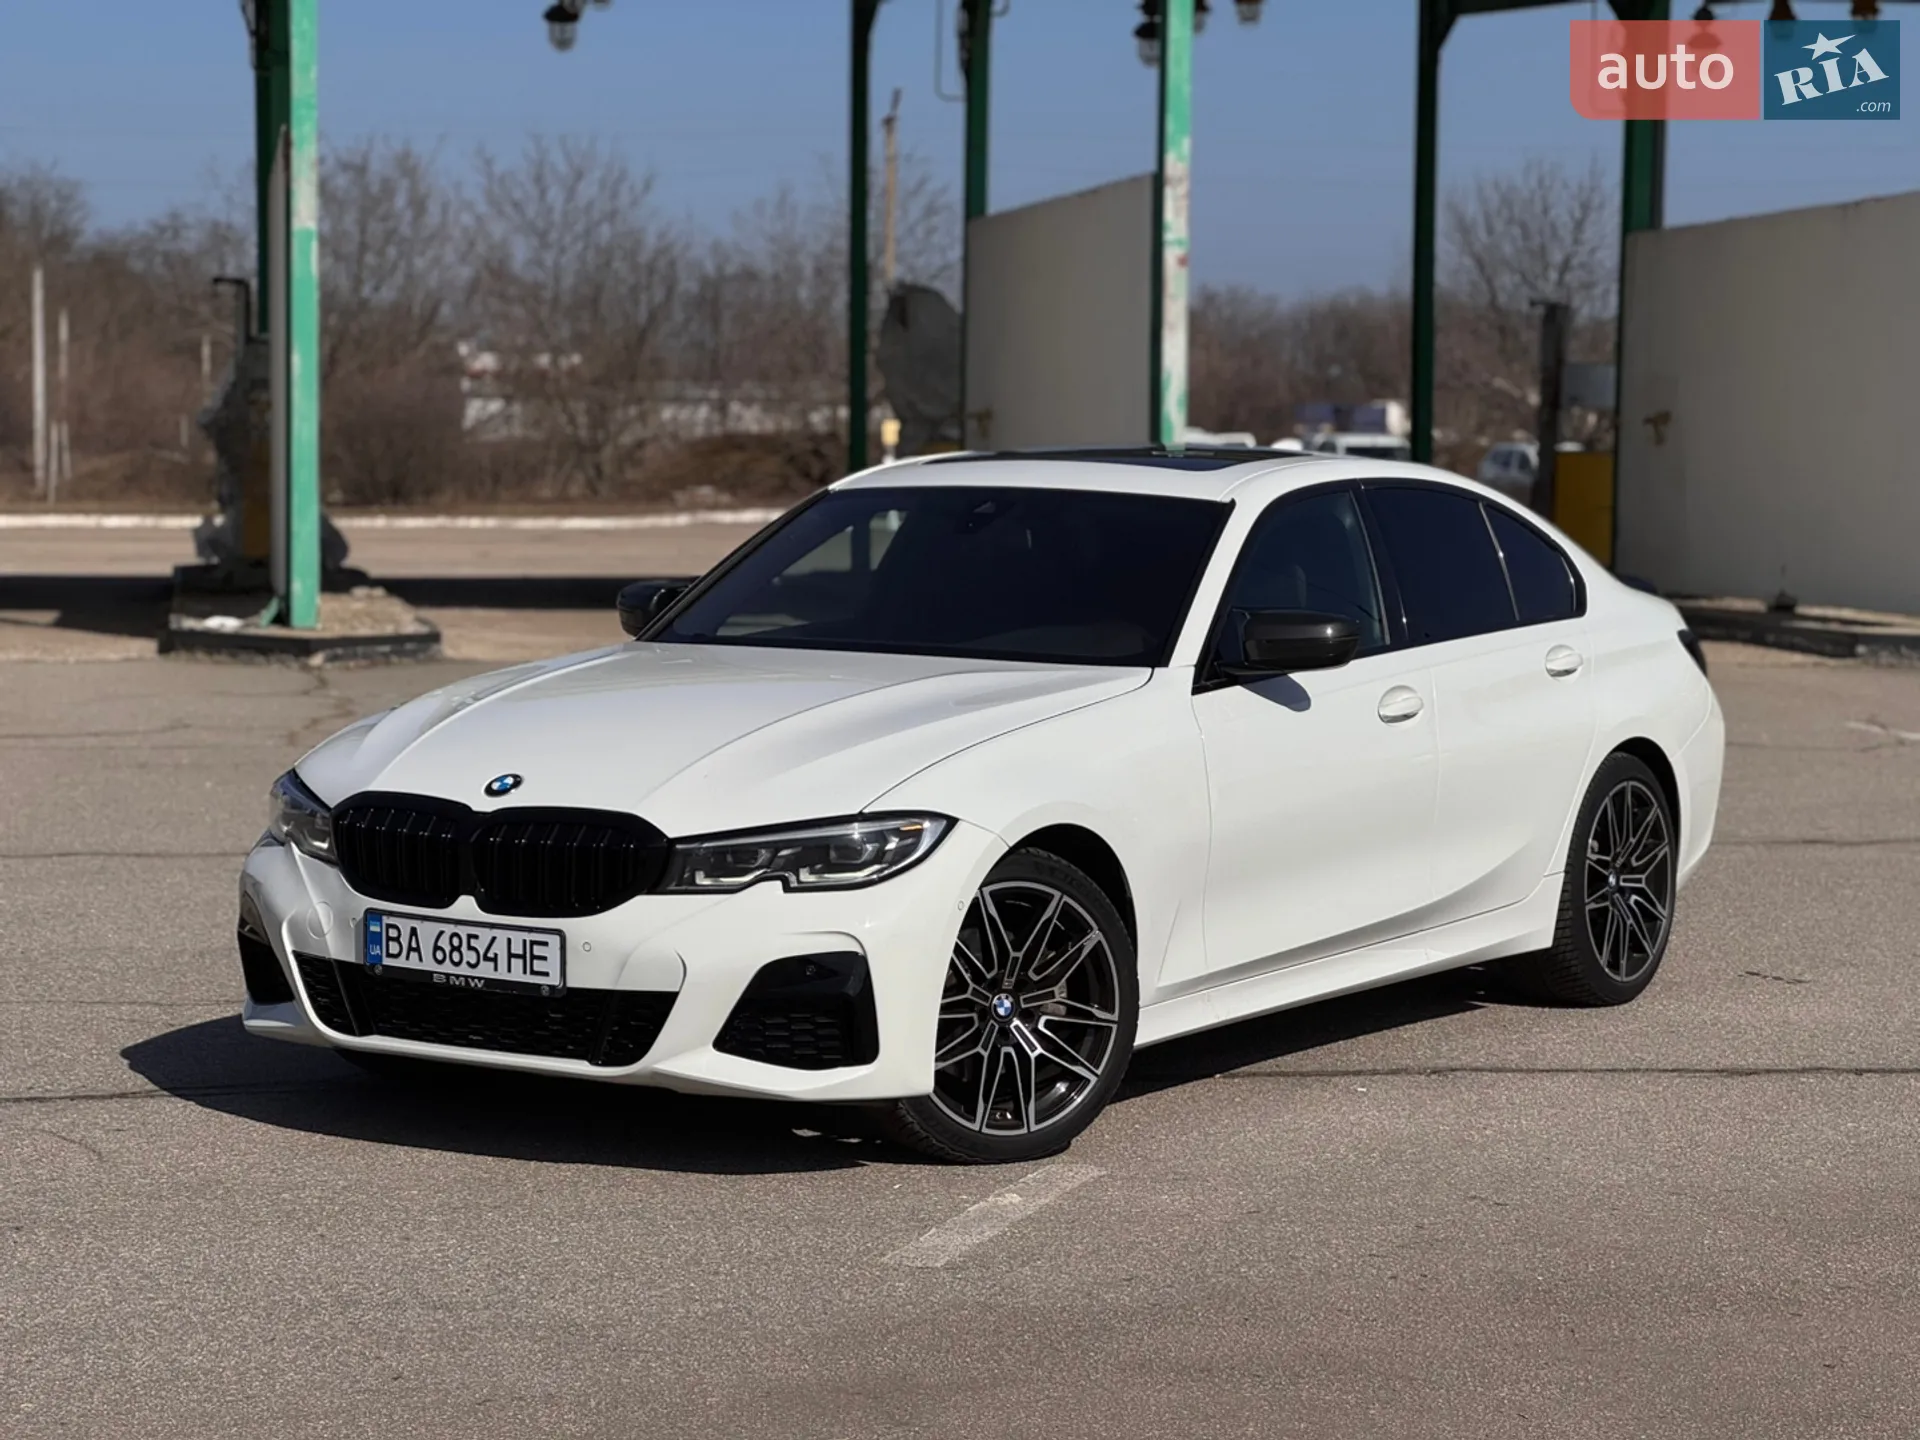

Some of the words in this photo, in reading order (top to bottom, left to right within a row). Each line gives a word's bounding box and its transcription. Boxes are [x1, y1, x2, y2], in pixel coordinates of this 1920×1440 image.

[369, 944, 382, 956] UA
[385, 923, 423, 963] BA
[432, 930, 498, 972] 6854
[506, 938, 550, 977] HE
[432, 973, 485, 989] BMW
